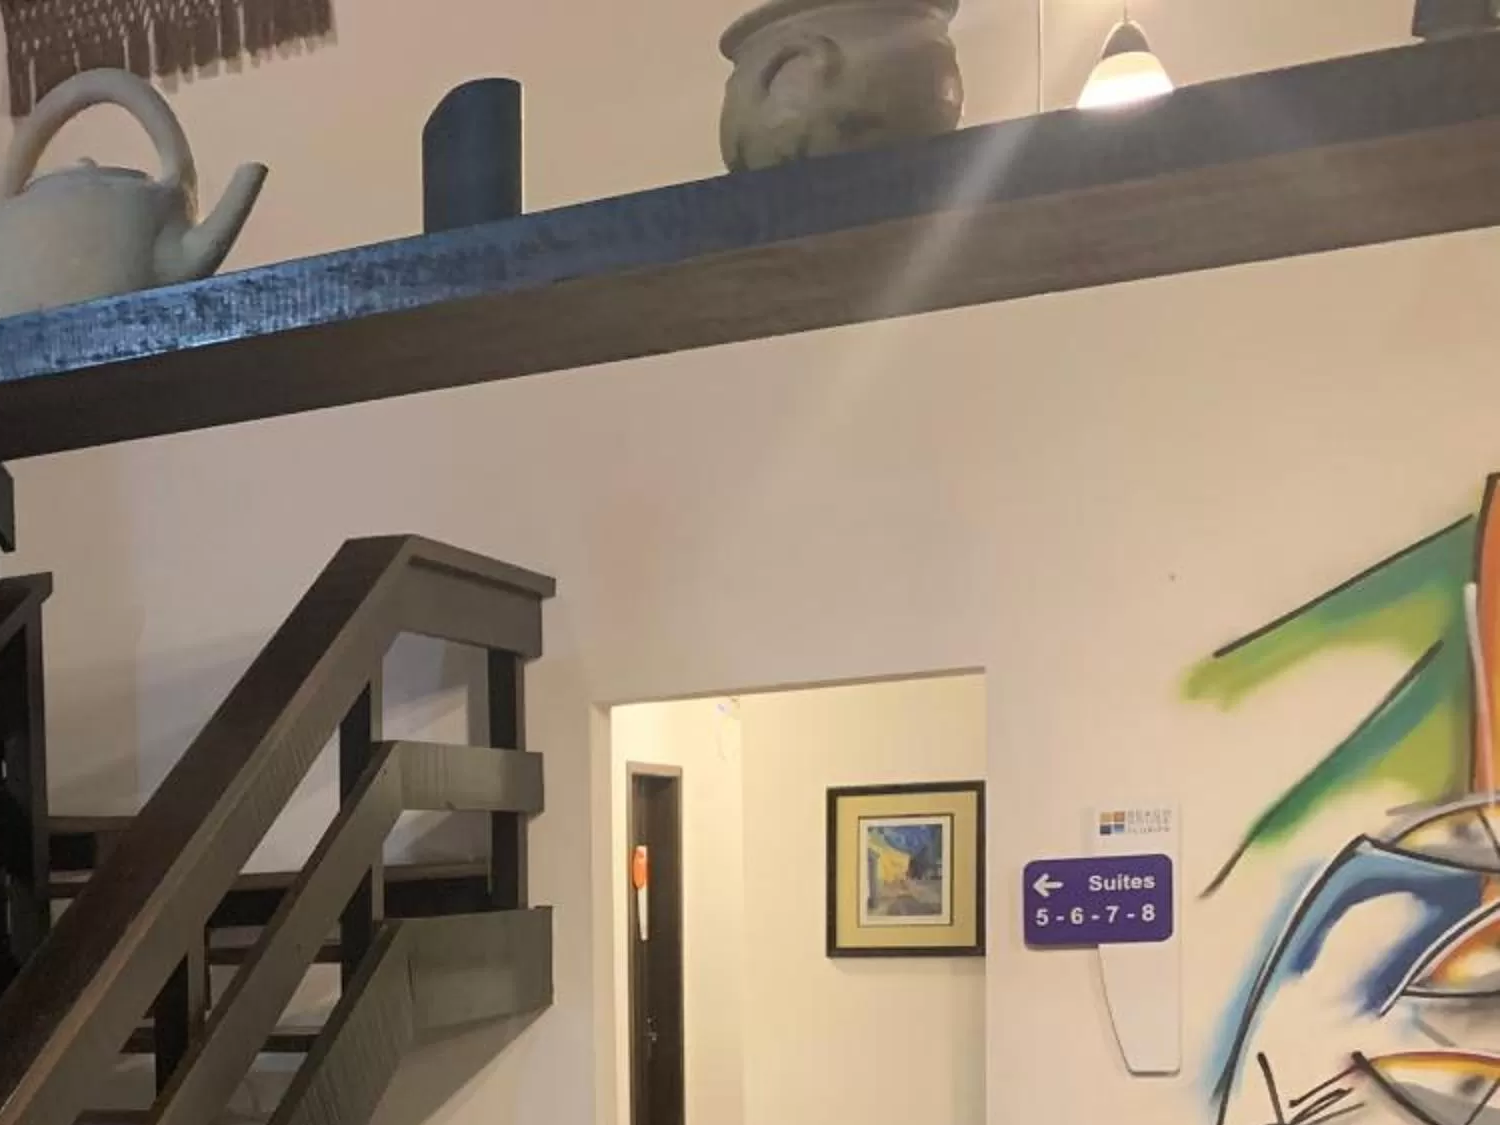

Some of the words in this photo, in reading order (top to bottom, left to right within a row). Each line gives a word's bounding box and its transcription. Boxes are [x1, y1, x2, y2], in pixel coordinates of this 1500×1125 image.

[1088, 873, 1156, 892] Suites
[1035, 908, 1049, 926] 5
[1070, 907, 1084, 925] 6
[1105, 905, 1120, 924] 7
[1141, 903, 1156, 922] 8
